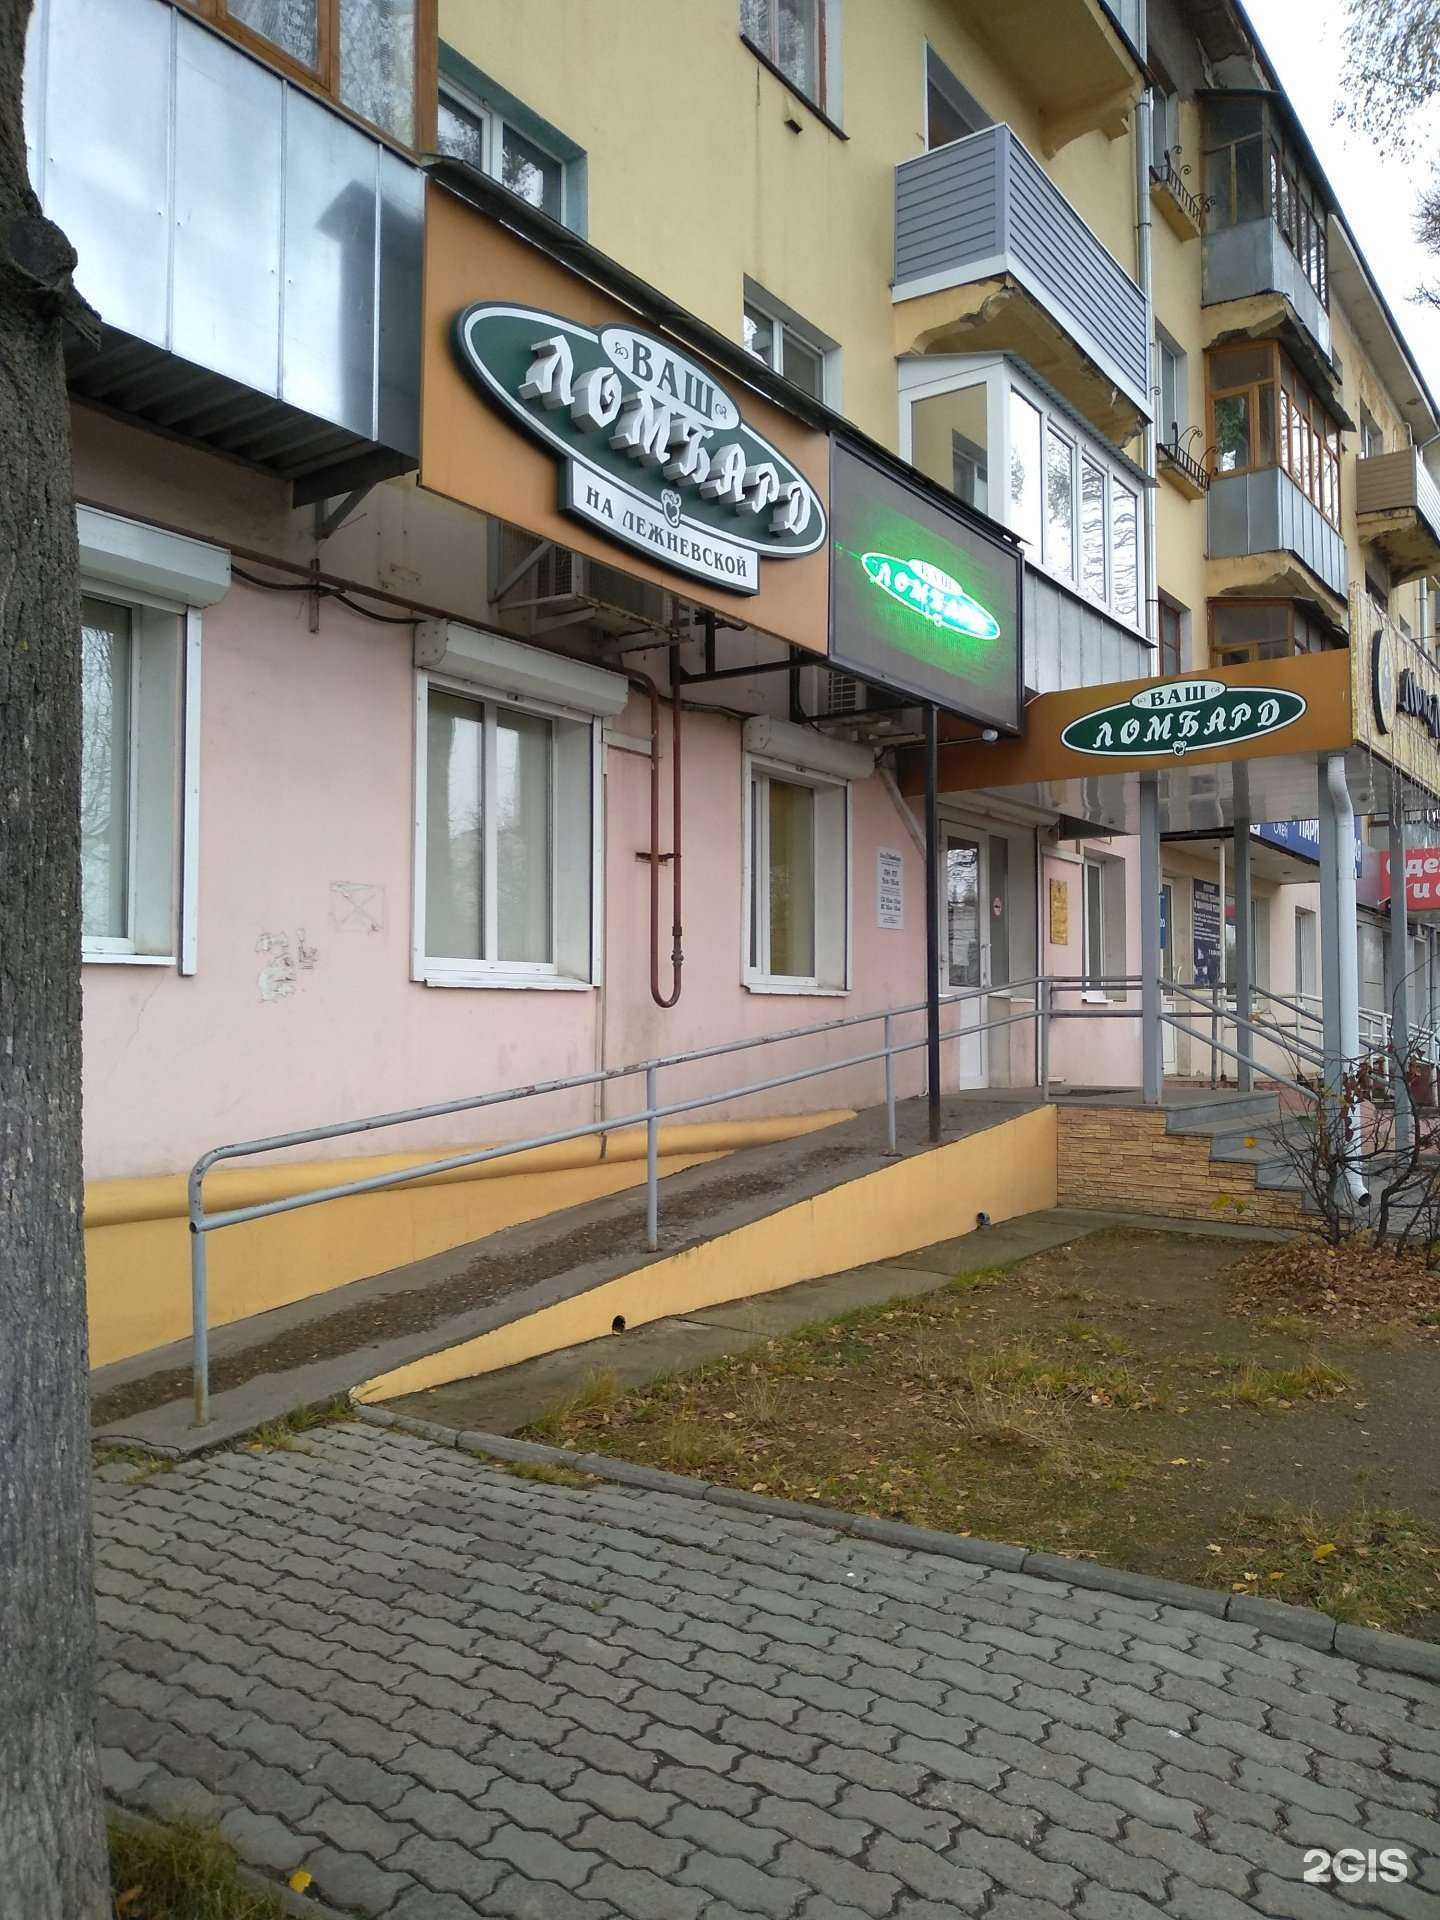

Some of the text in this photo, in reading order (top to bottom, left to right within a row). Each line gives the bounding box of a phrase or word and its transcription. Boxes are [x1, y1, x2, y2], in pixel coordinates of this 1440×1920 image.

[630, 339, 715, 421] ВАШ
[518, 335, 812, 536] ЛОМБАРД
[585, 484, 748, 578] НА ЛЕЖНЕВСКОЙ
[1092, 698, 1281, 749] ЛОМБАРД
[1150, 685, 1207, 708] ВАШ
